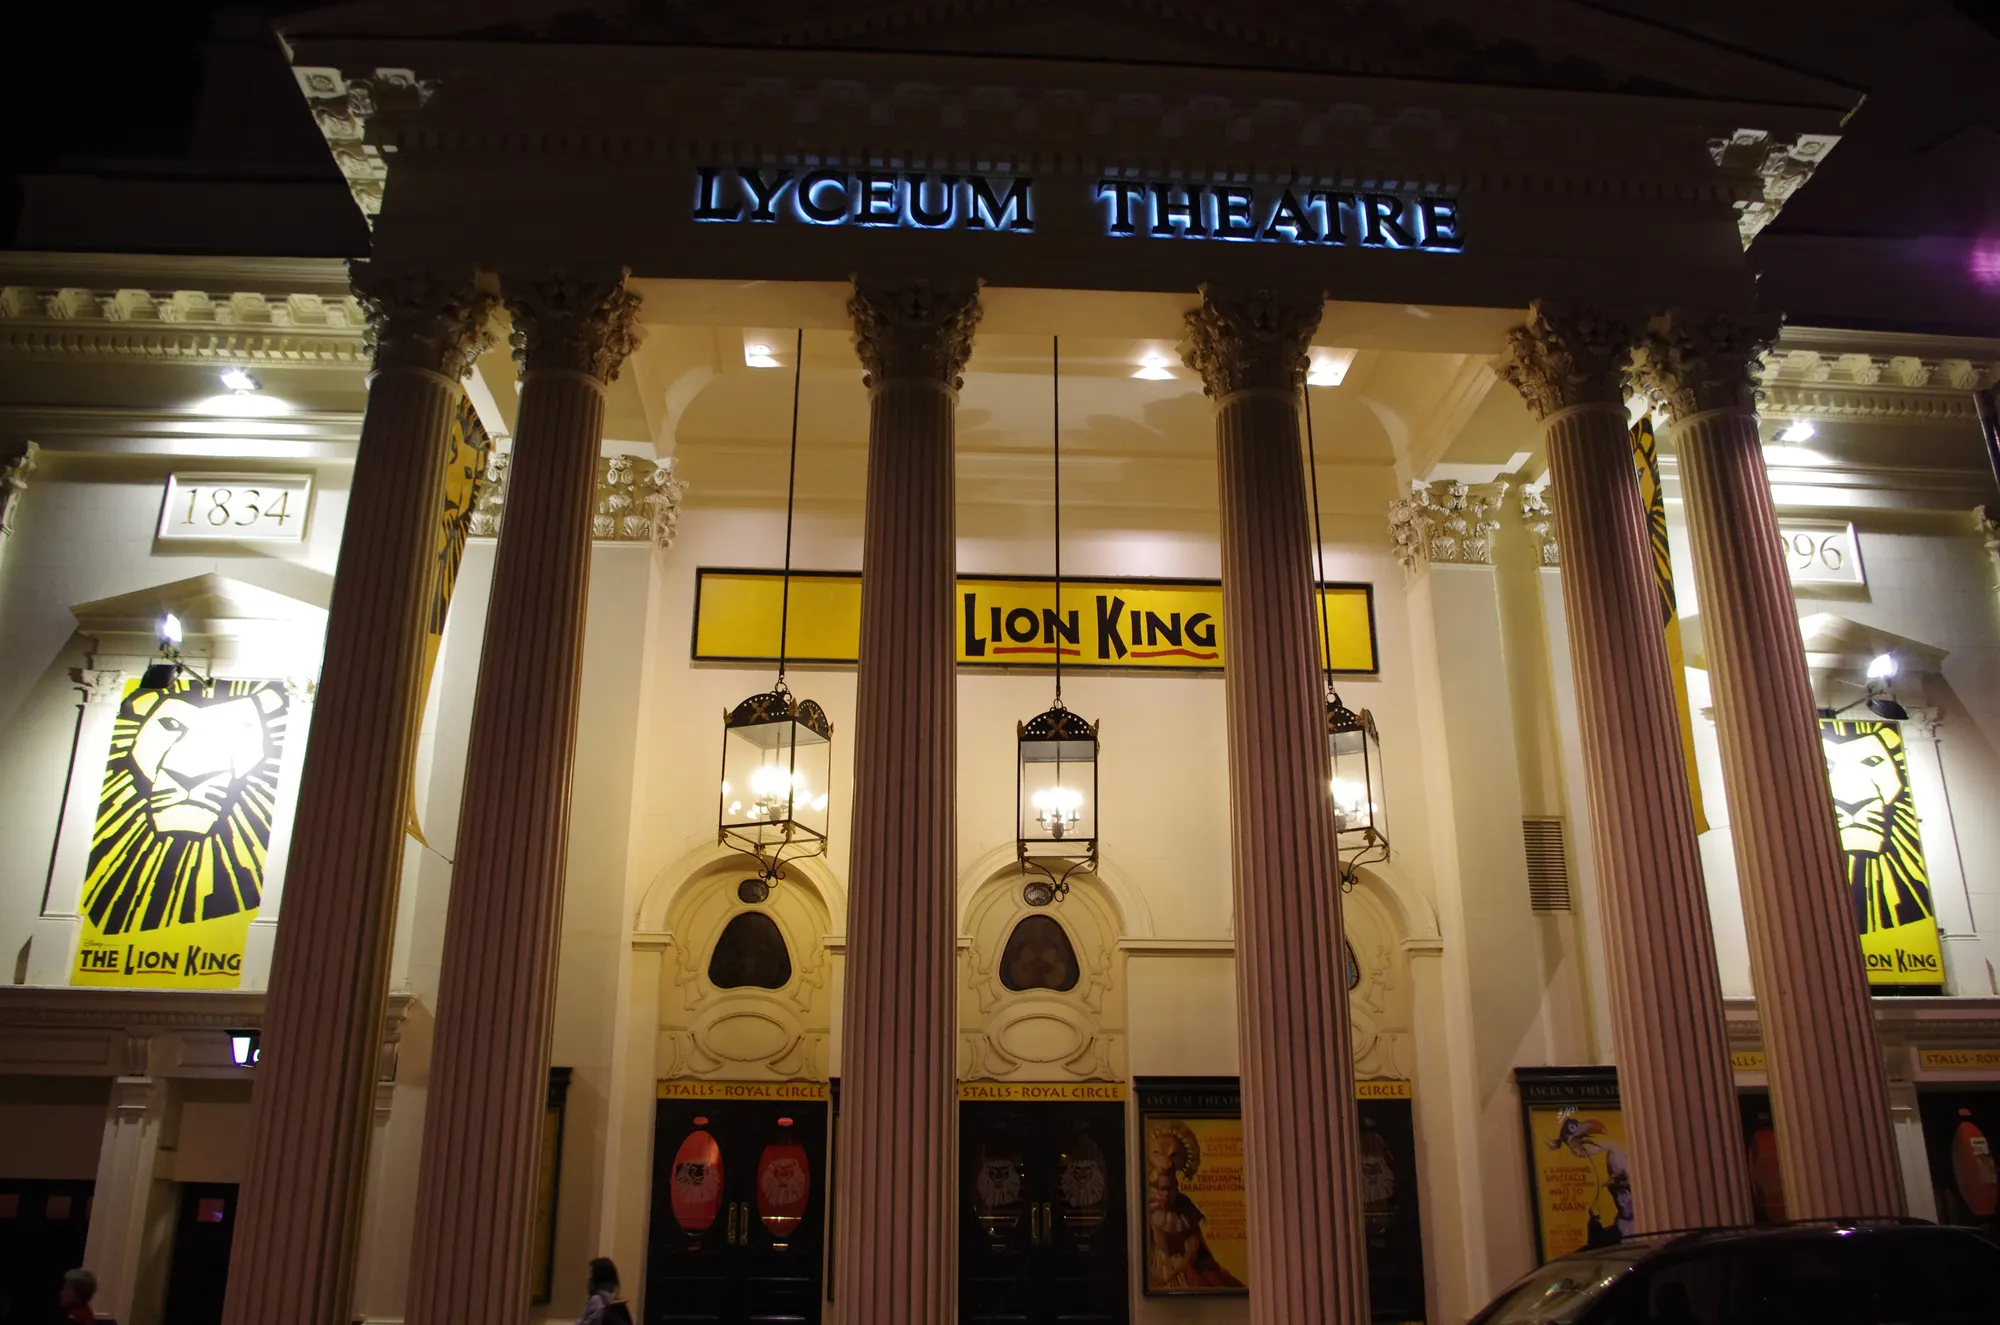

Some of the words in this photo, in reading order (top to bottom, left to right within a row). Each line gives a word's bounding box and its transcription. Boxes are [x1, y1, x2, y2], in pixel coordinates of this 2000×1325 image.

[693, 167, 1035, 232] LYCEUM
[1097, 177, 1466, 251] THEATRE
[181, 488, 290, 526] 1834
[963, 593, 1080, 657] LION
[1096, 595, 1217, 660] KING
[80, 950, 119, 967] THE
[124, 944, 179, 975] LION
[184, 945, 241, 976] KING
[1895, 948, 1937, 973] KING
[776, 1085, 825, 1098] CIRCLE
[1072, 1086, 1119, 1098] CIRCLE
[1359, 1084, 1405, 1096] CIRCLE
